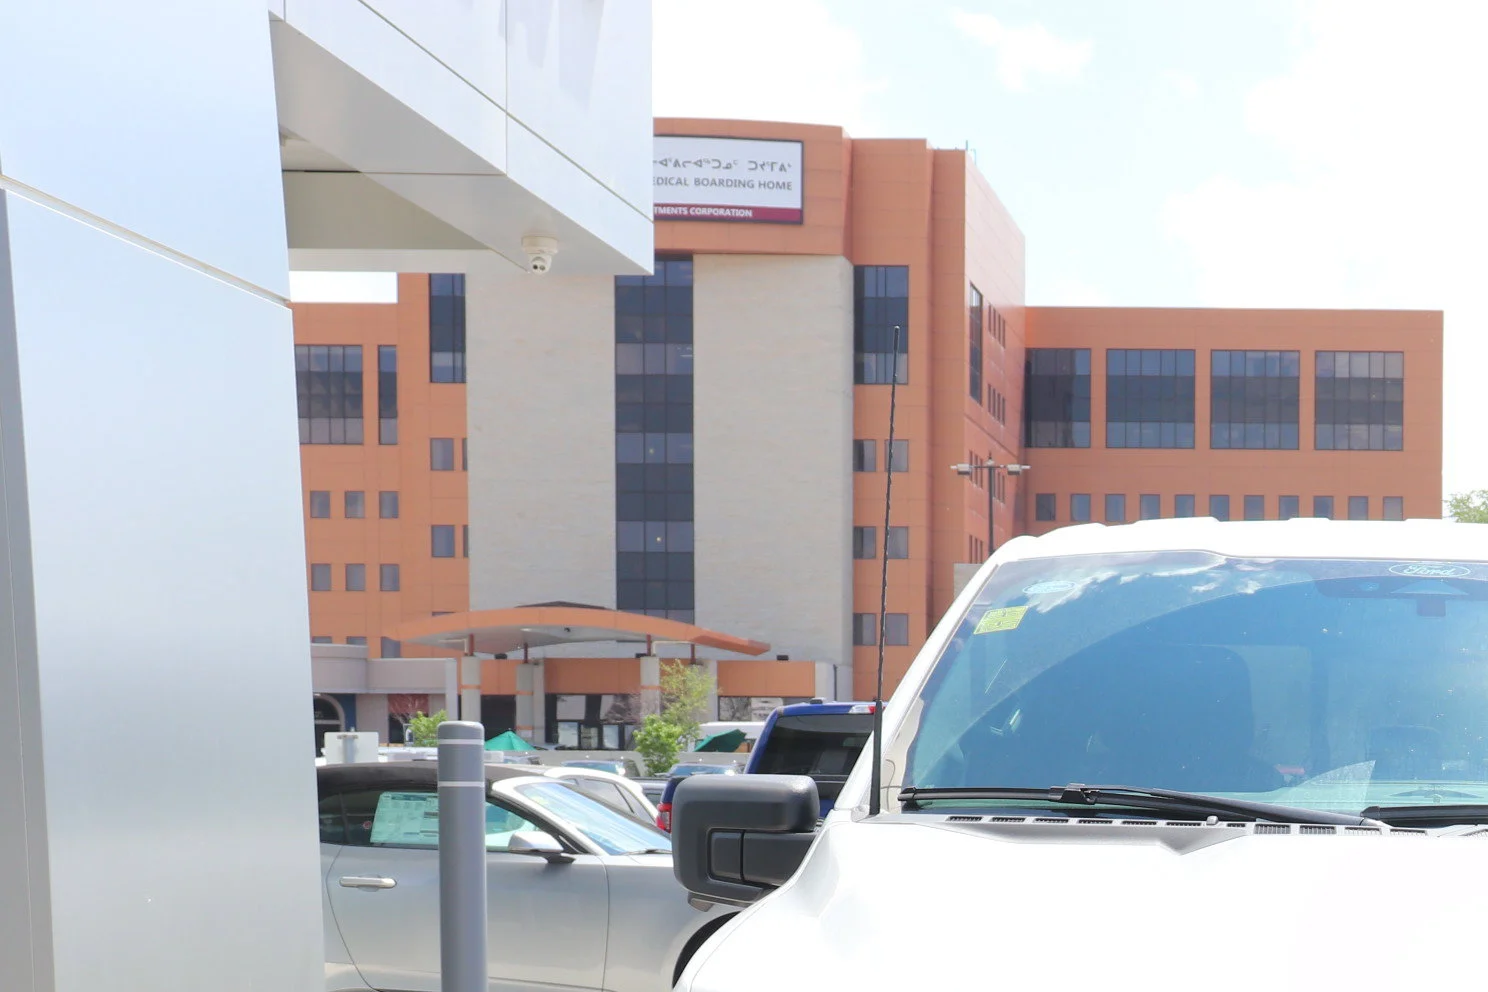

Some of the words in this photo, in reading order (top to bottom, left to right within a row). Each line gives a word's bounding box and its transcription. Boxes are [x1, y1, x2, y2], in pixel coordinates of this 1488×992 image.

[694, 177, 754, 189] BOARDING
[758, 180, 793, 191] HOME
[689, 207, 753, 217] CORPORATION
